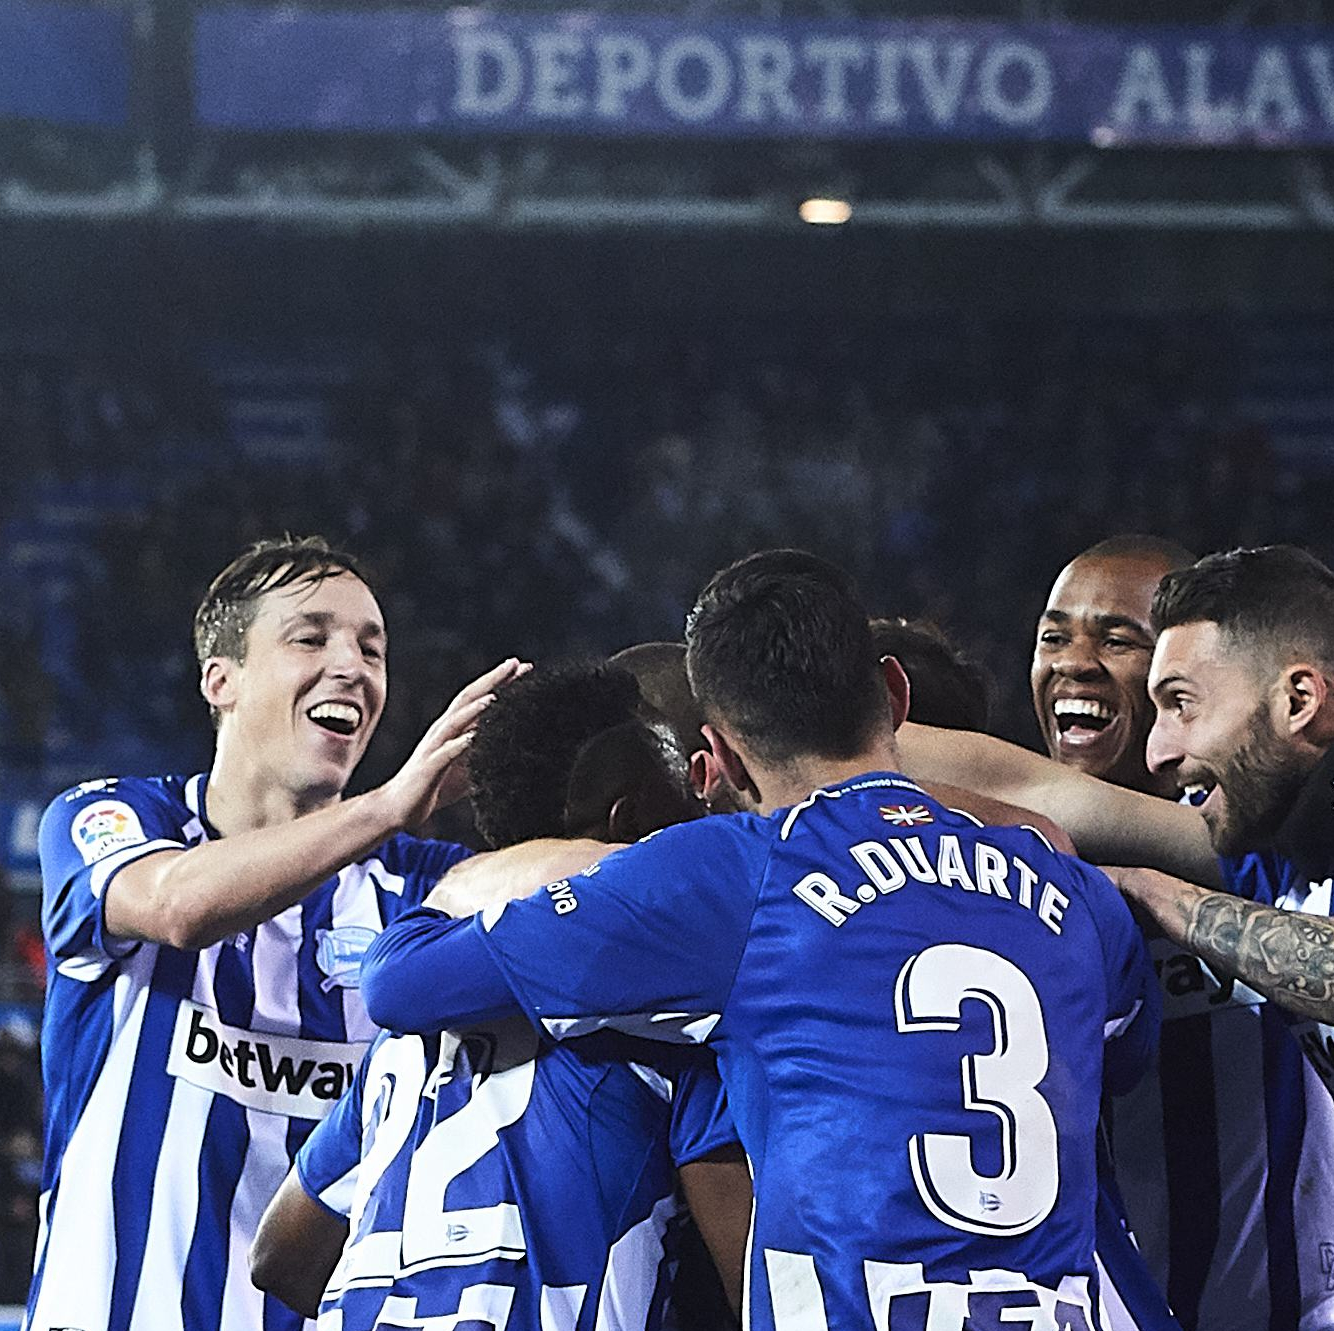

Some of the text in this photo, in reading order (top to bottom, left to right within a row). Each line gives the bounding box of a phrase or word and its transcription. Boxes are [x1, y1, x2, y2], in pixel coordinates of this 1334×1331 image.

[453, 31, 1055, 123] DEPORTIVO
[791, 834, 1070, 936] R.DUARTE
[185, 1010, 357, 1101] betwa
[895, 943, 1060, 1236] 3
